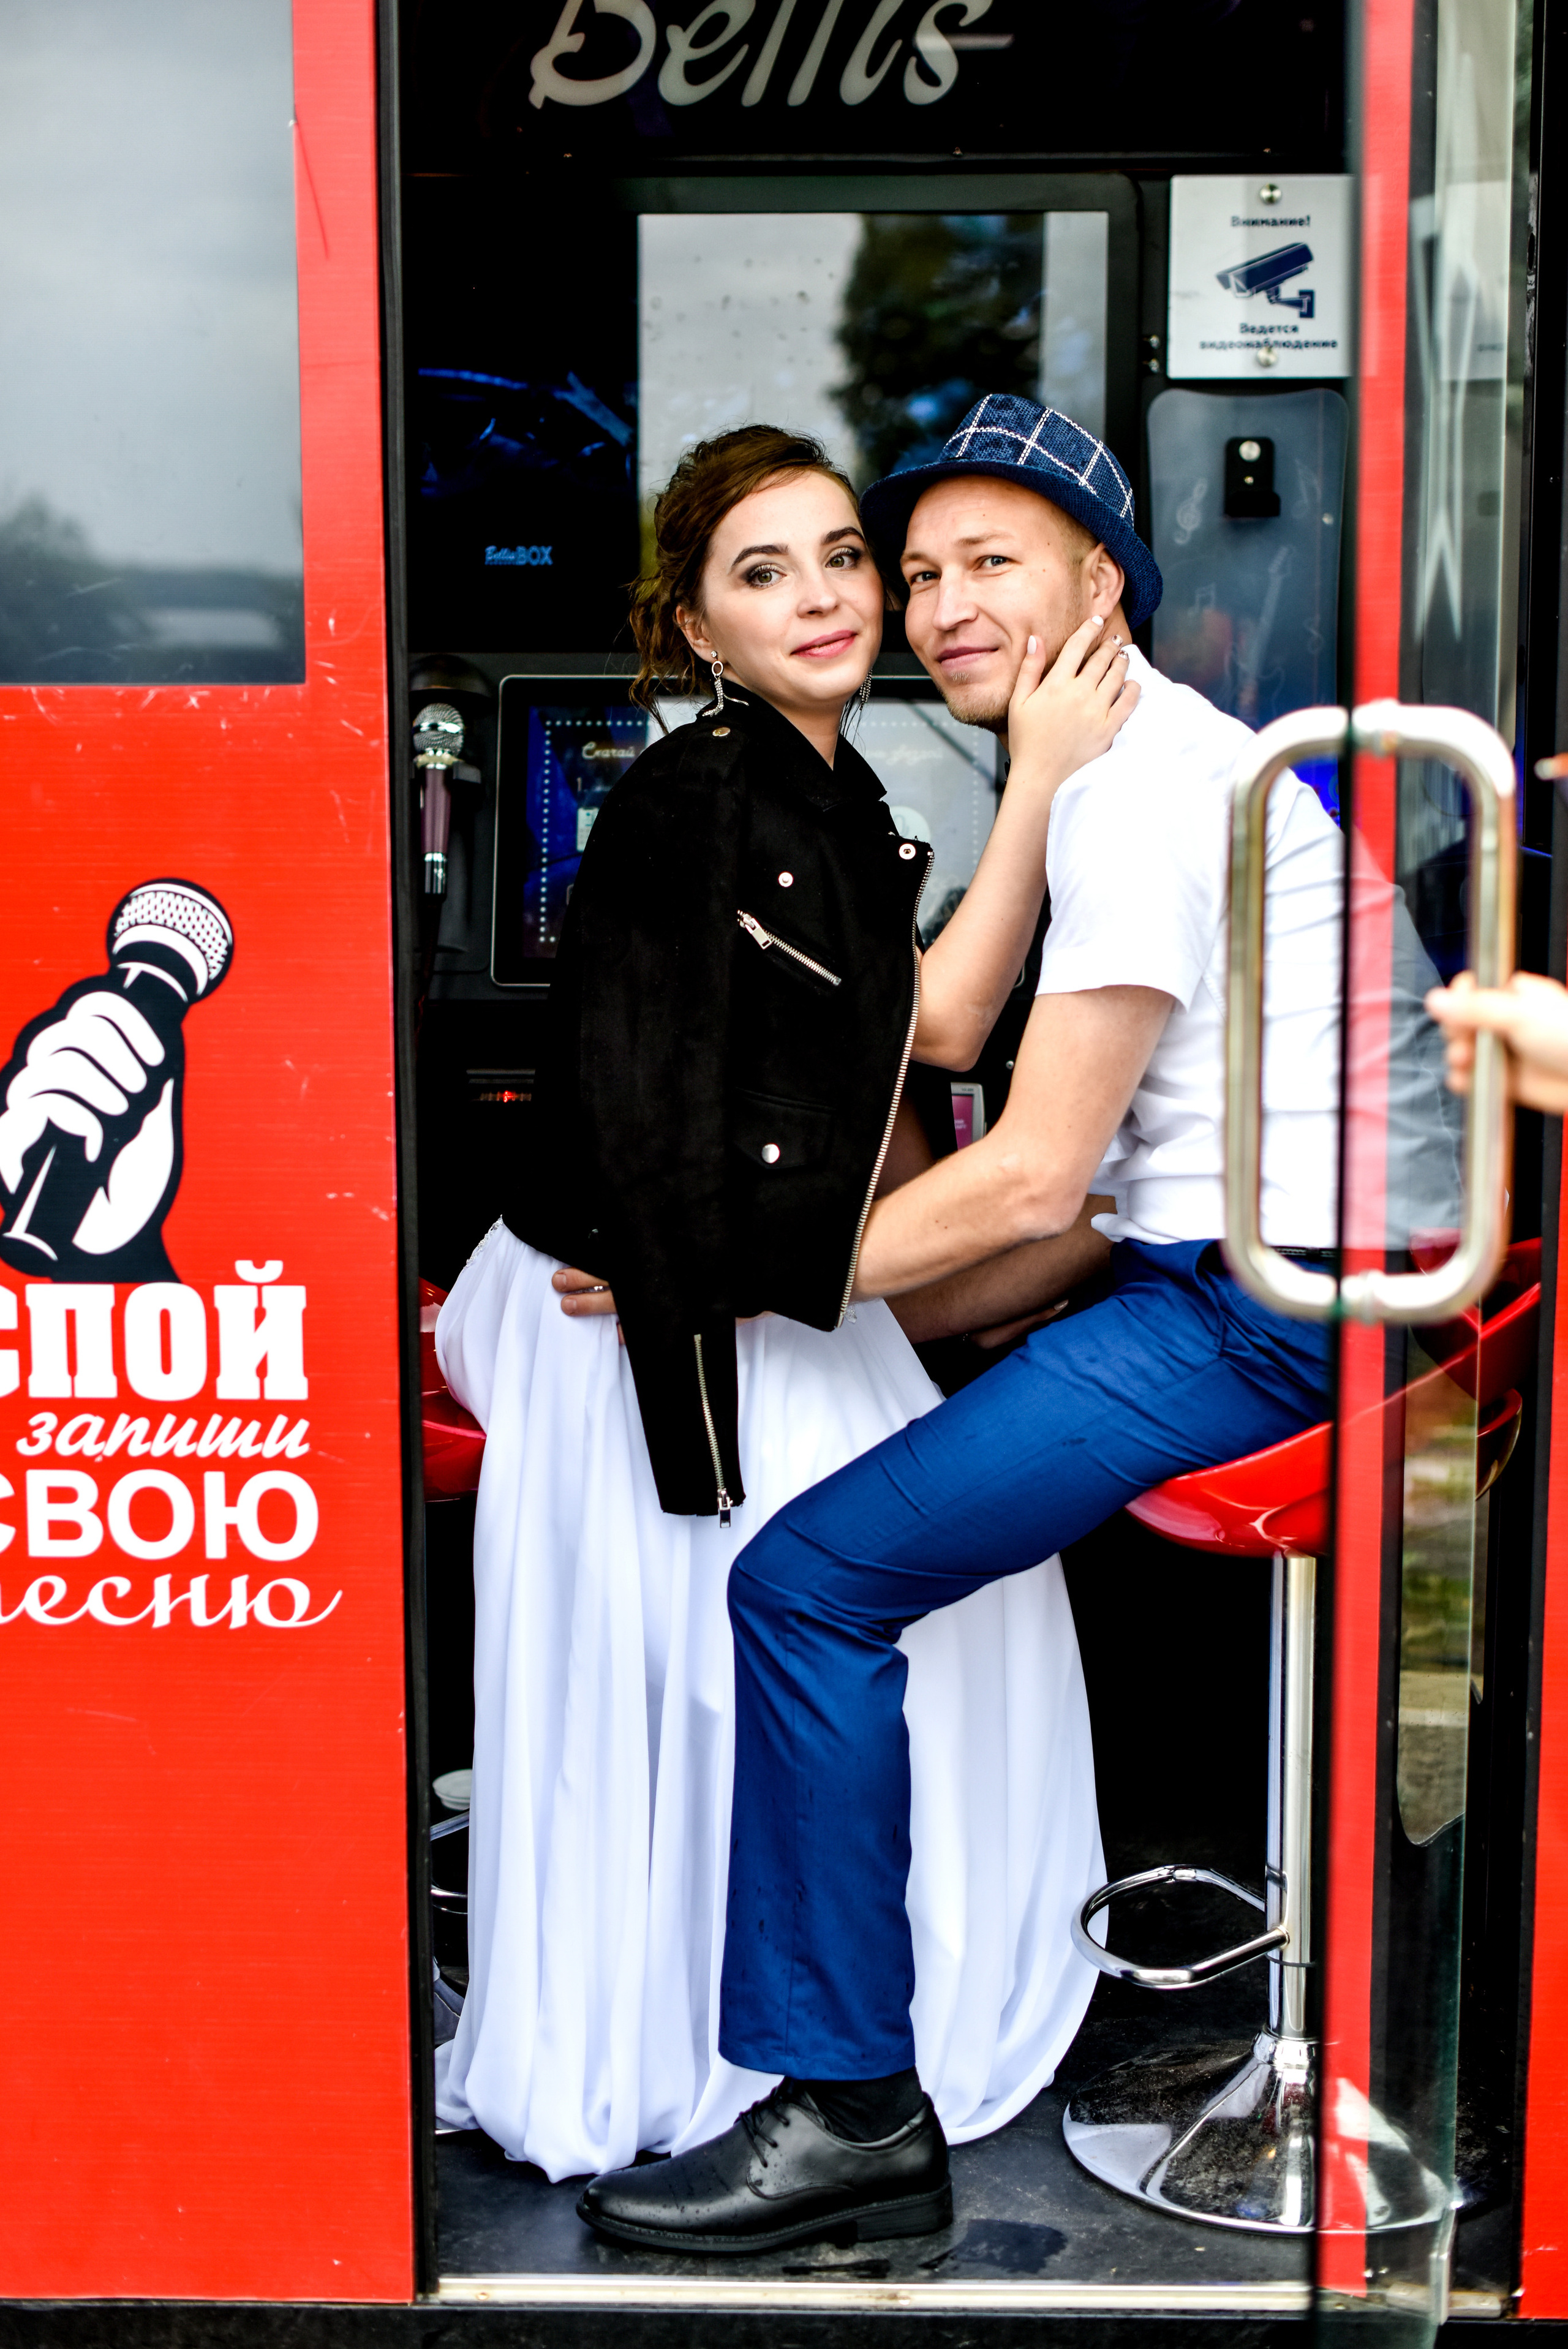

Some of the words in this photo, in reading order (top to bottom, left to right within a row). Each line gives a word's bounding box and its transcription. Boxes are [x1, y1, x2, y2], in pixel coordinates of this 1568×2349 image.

[1231, 214, 1311, 227] Внимание!
[1199, 338, 1338, 350] видеонаблюдение
[1239, 322, 1299, 334] Ведется
[0, 1260, 308, 1401] ПОЙ
[16, 1412, 310, 1459] запиши
[0, 1469, 318, 1561] ВОЮ
[0, 1573, 342, 1630] есню
